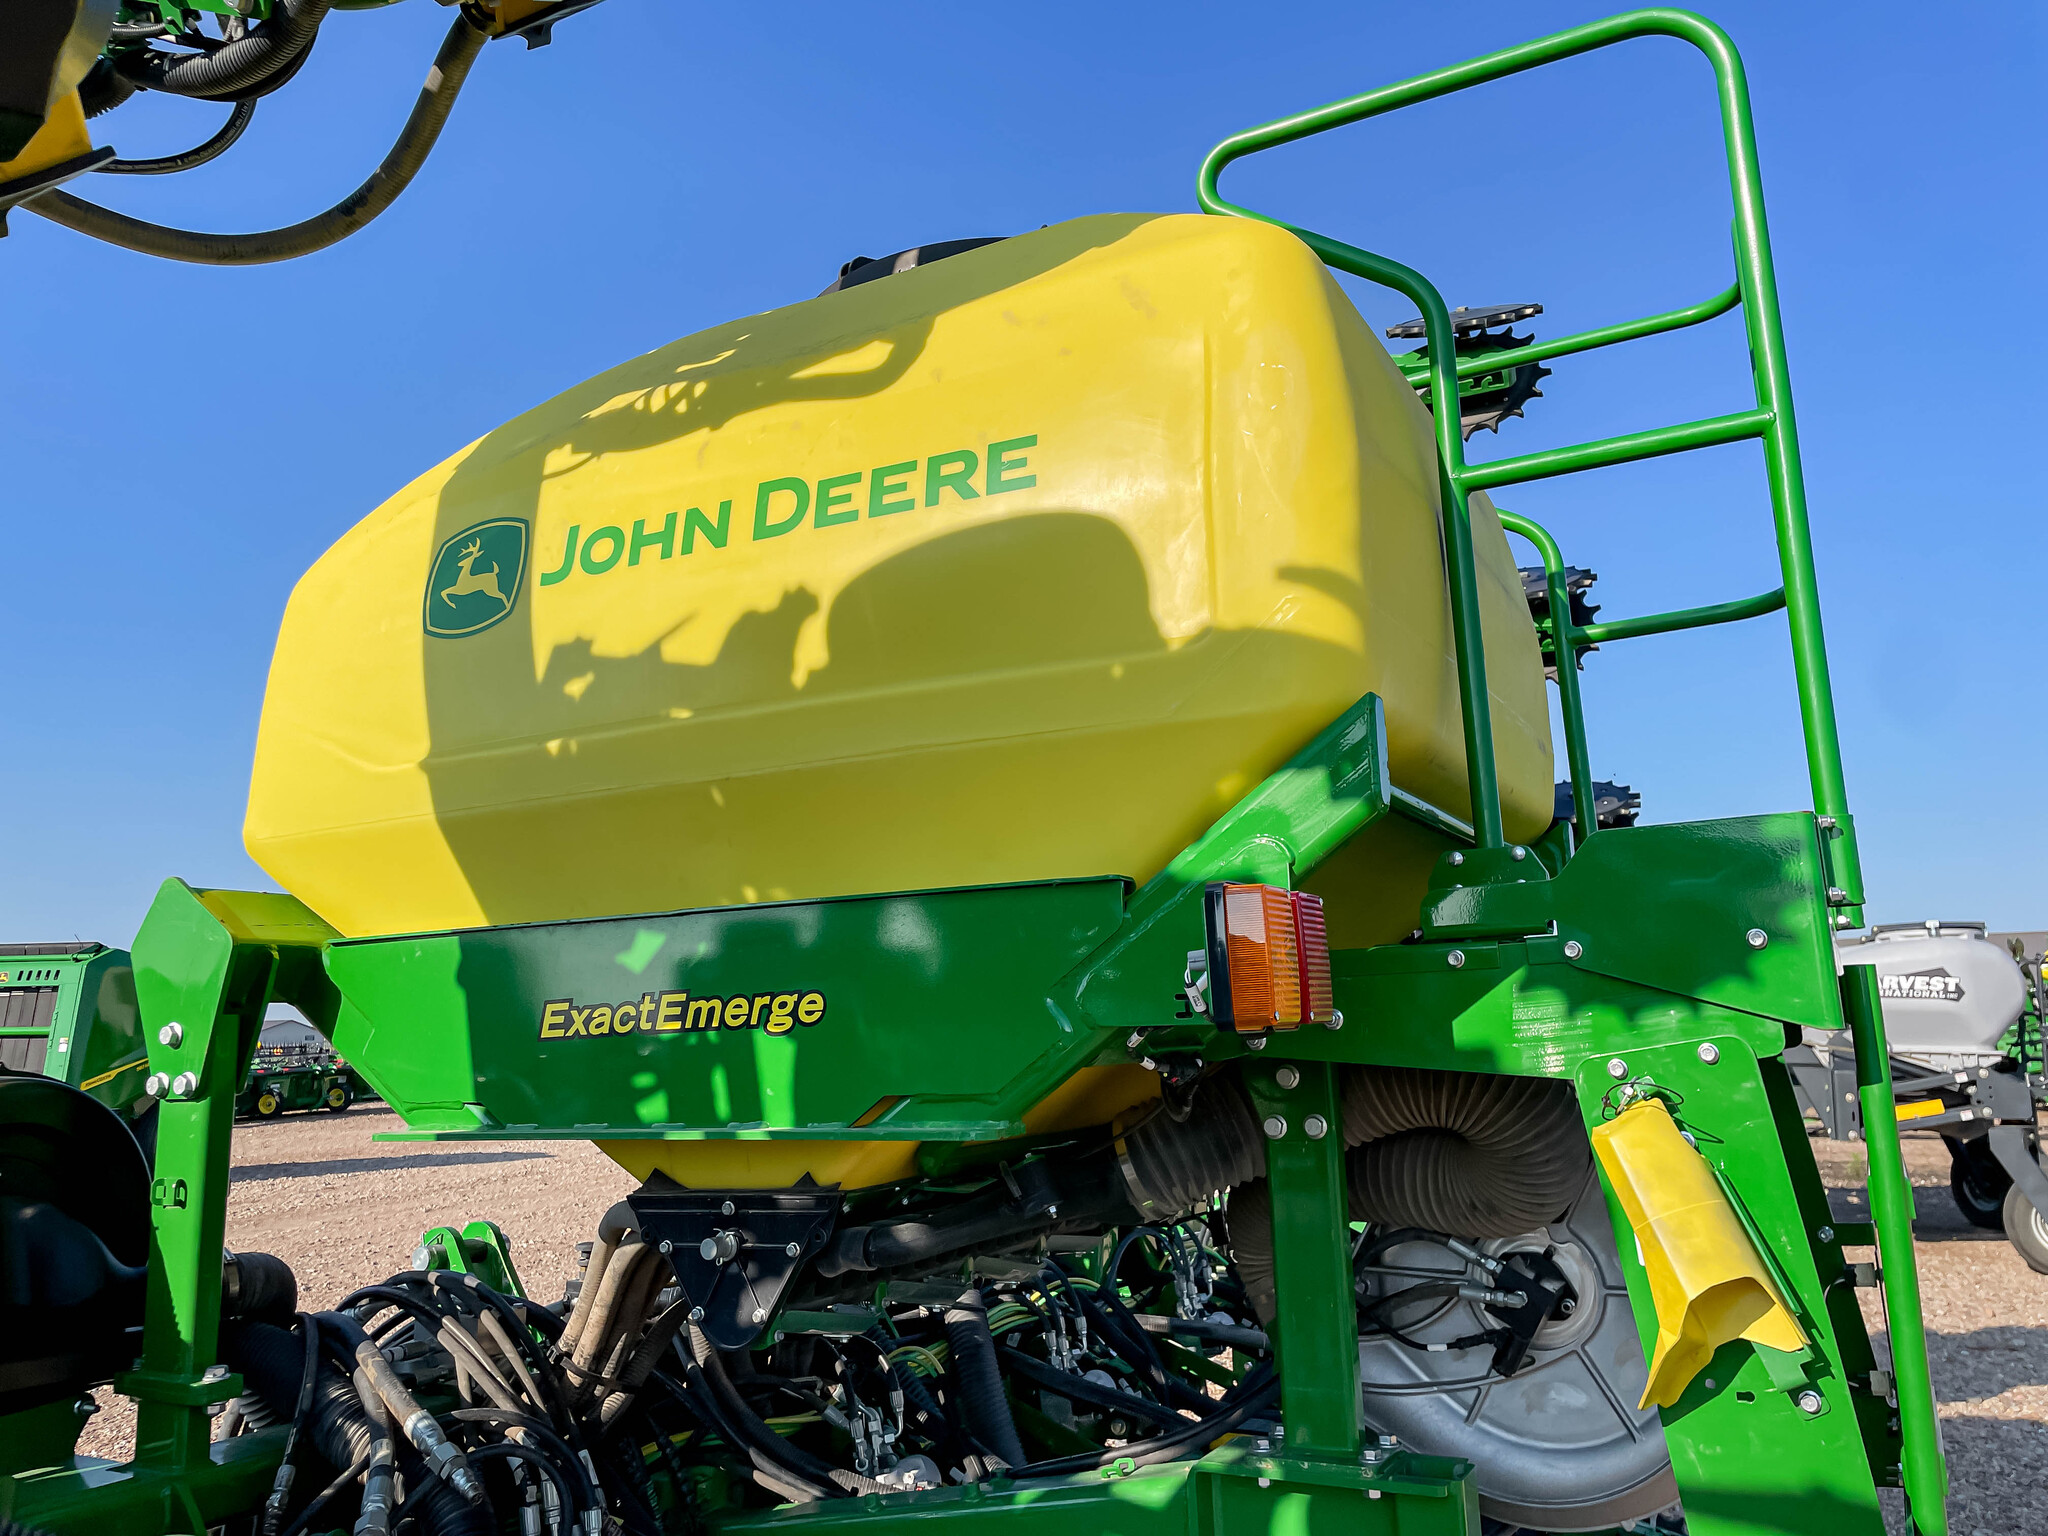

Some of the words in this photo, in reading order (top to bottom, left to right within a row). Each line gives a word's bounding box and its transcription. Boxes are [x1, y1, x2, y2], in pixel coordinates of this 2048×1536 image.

[540, 500, 732, 587] JOHN
[752, 434, 1038, 541] DEERE
[539, 991, 826, 1038] ExactEmerge
